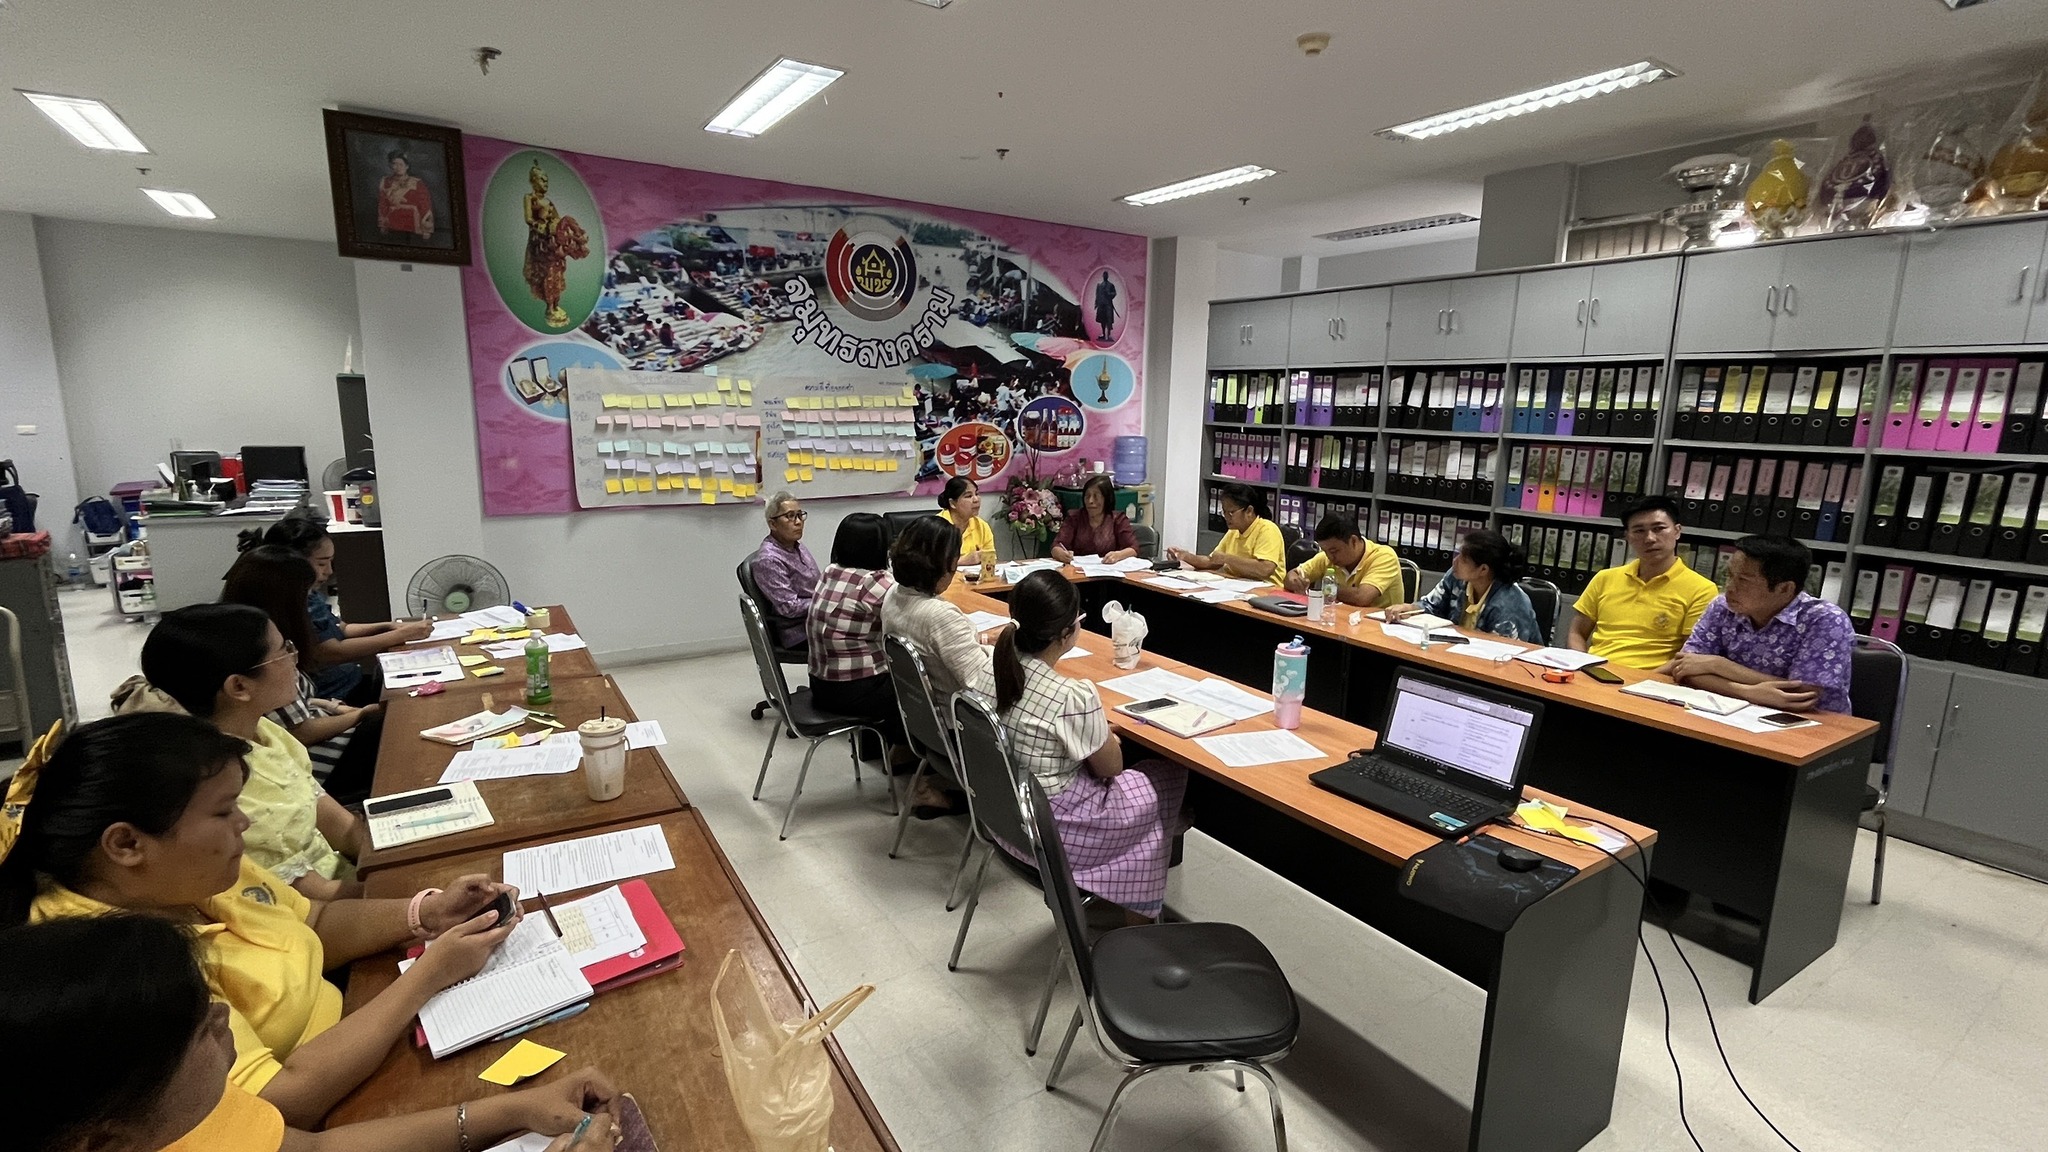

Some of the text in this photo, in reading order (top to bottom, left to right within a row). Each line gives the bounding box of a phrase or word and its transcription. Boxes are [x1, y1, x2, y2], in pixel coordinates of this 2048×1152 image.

[784, 274, 955, 369] สมุทรสงคราม
